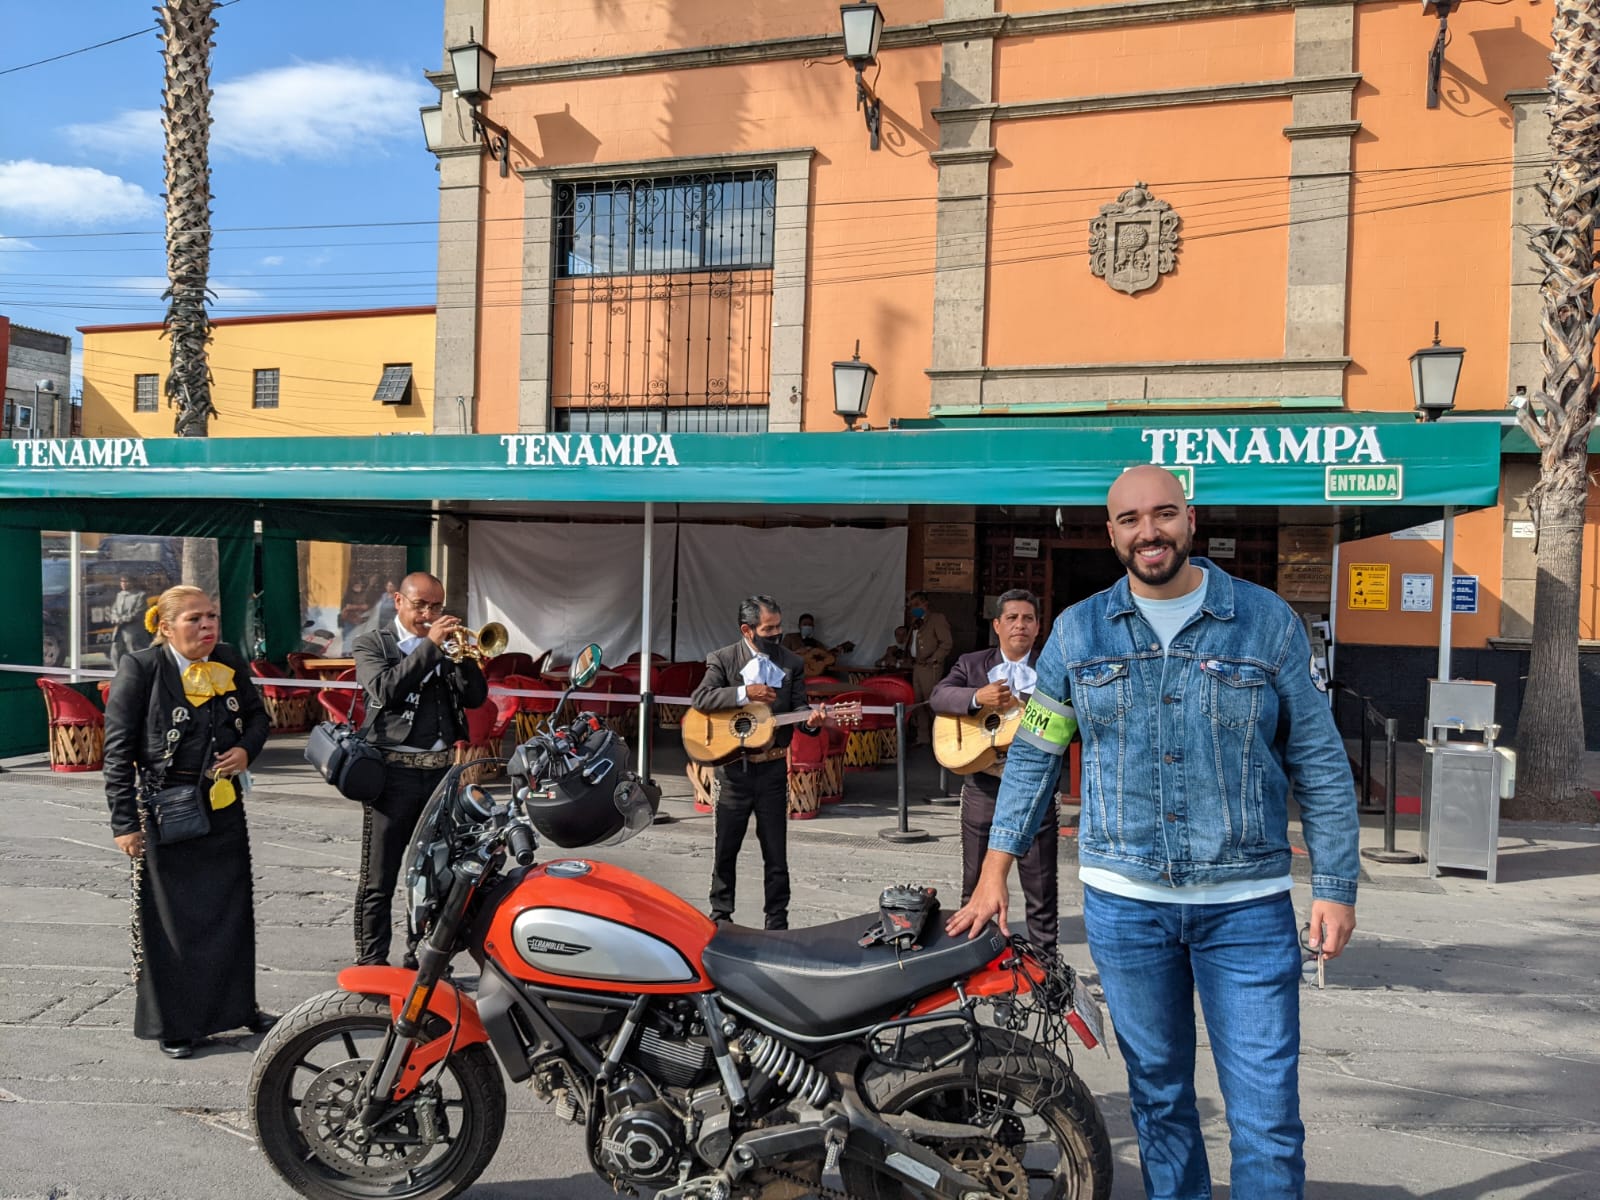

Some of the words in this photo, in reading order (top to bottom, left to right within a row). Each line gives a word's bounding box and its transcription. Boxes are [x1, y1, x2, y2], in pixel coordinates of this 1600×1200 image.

[12, 438, 149, 467] TENAMPA
[500, 433, 679, 466] TENAMPA
[1141, 426, 1386, 465] TENAMPA
[1330, 474, 1397, 492] ENTRADA
[531, 938, 566, 951] SCRAMBLER
